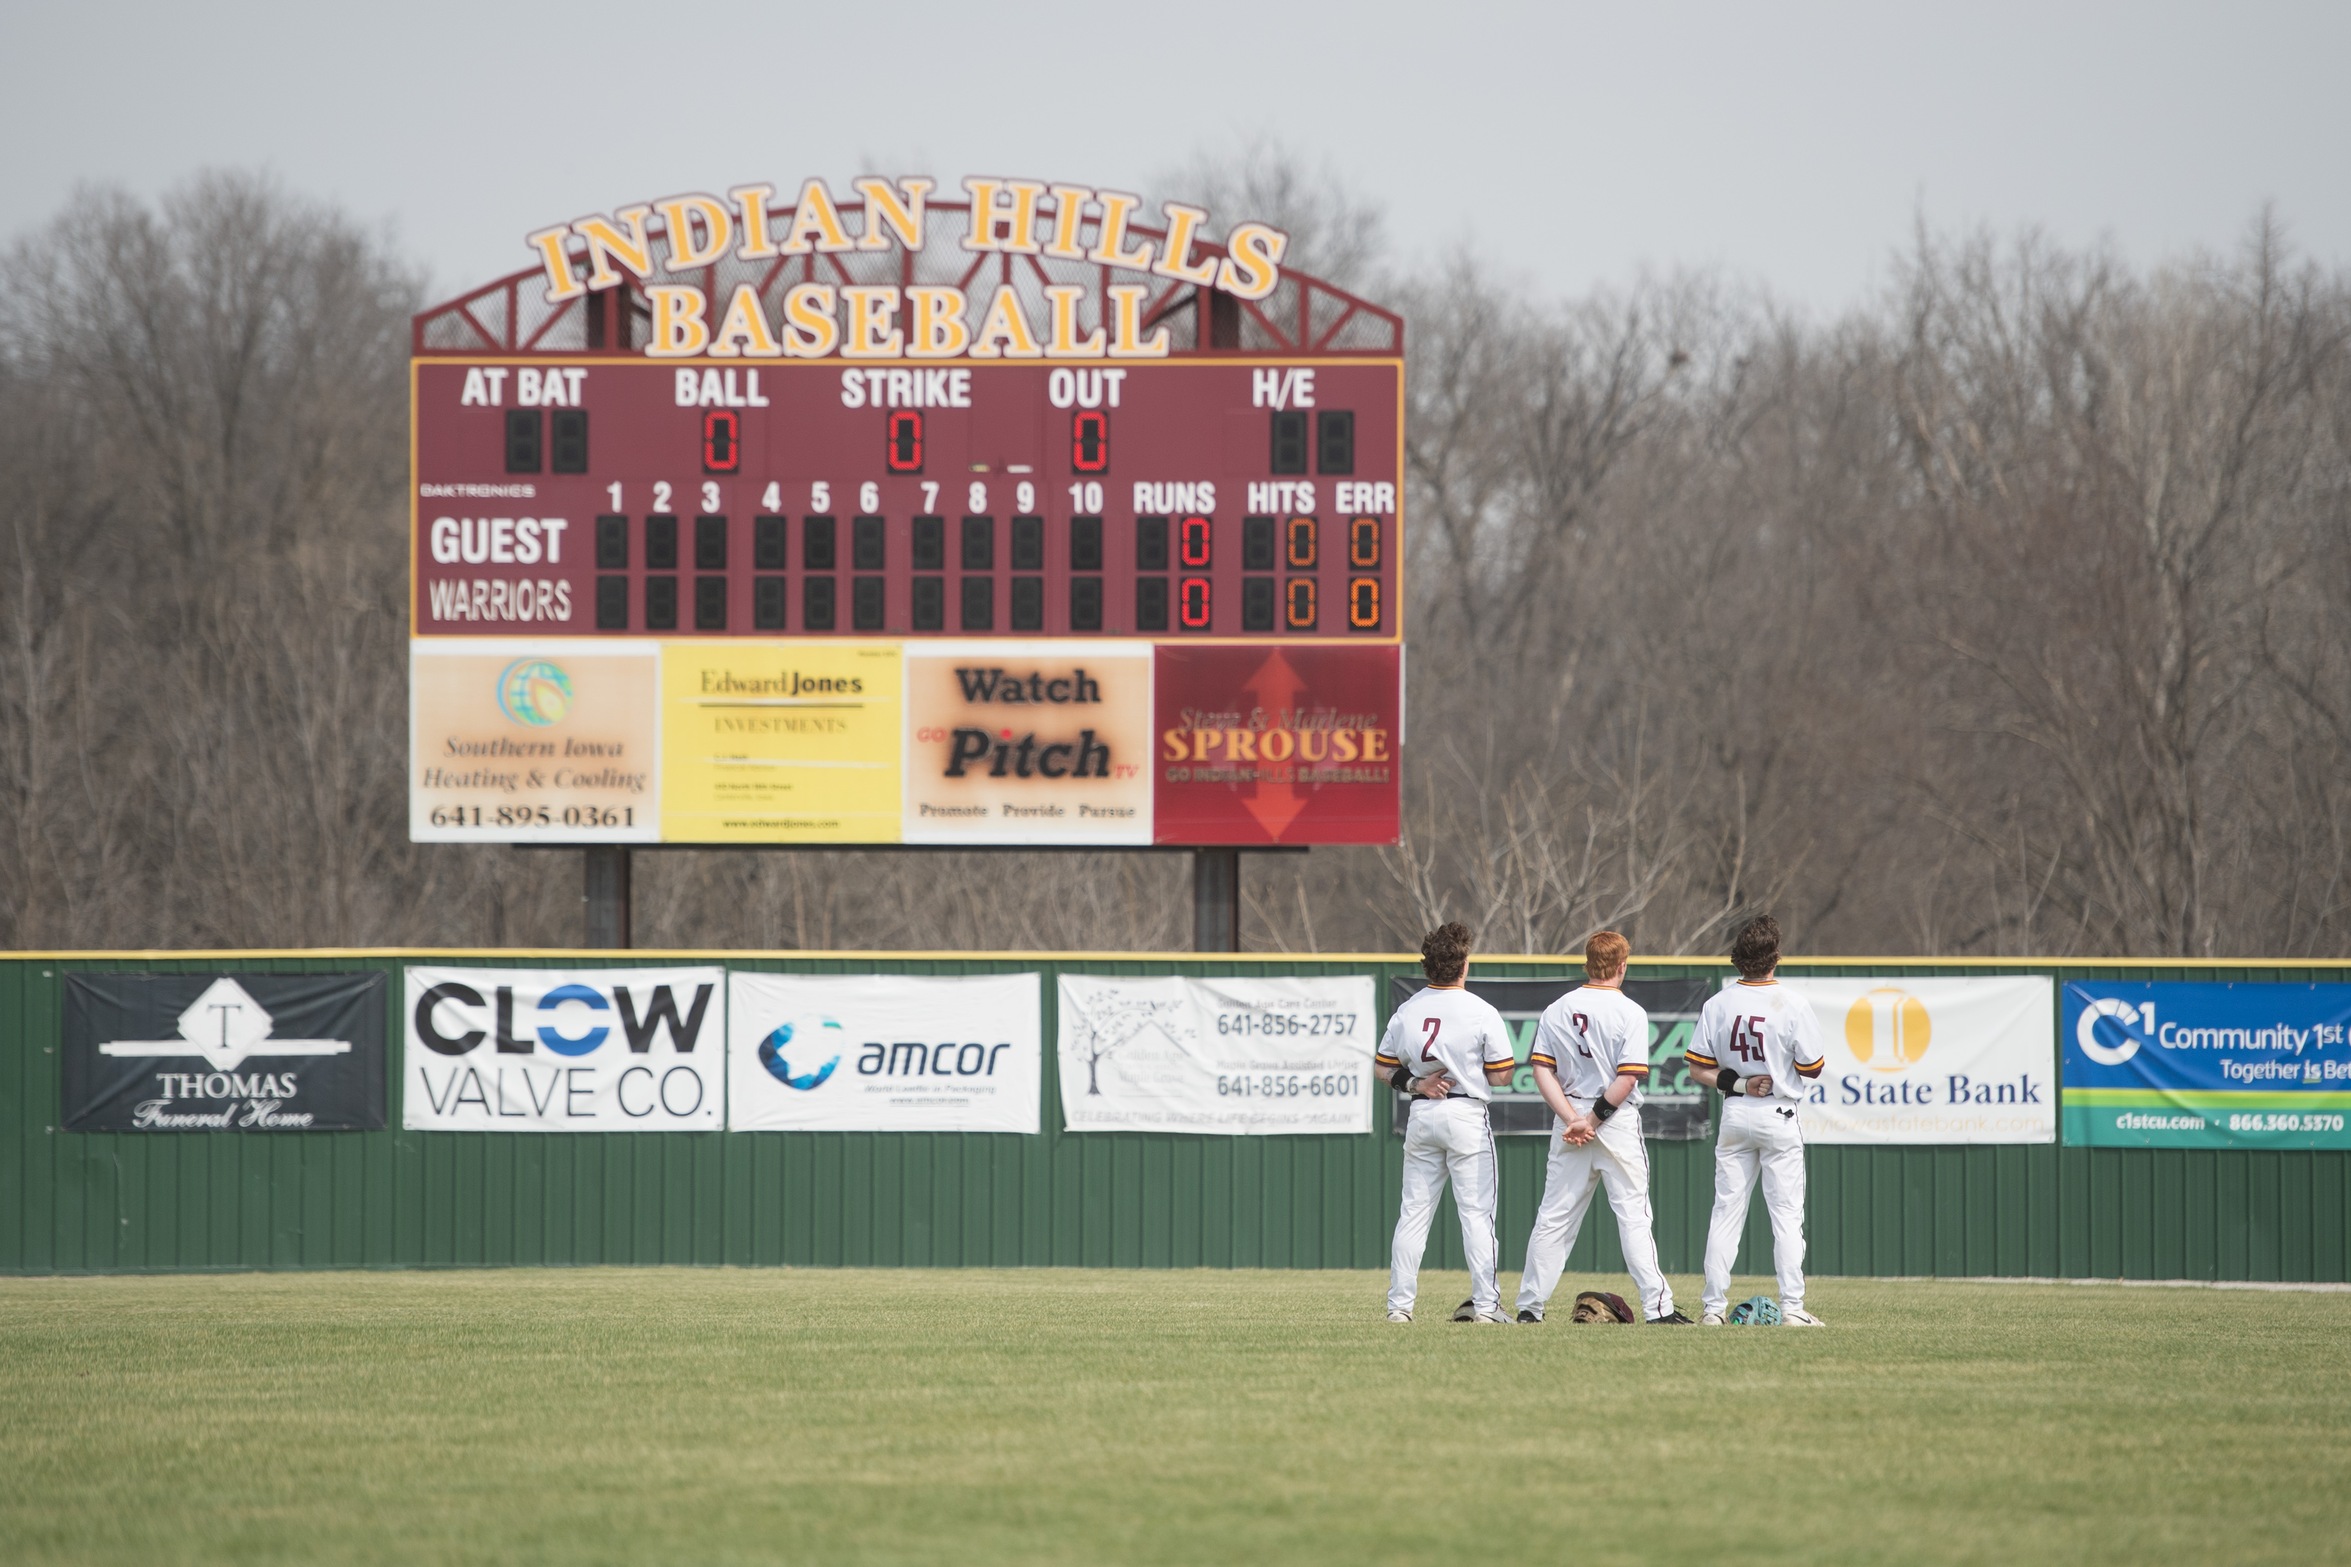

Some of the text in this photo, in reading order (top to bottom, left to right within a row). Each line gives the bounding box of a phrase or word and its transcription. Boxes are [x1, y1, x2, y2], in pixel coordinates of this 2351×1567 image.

[527, 175, 1288, 302] INDIAN HILLS
[645, 283, 1170, 358] BASEBALL
[461, 368, 588, 407] AT BAT
[675, 368, 770, 407] BALL
[840, 367, 972, 408] STRIKE
[1049, 368, 1127, 408] OUT
[1252, 367, 1316, 411] H/E
[704, 410, 738, 470] 0
[889, 411, 922, 471] 0
[1073, 411, 1108, 471] 0
[420, 483, 536, 498] DAKTRONICS
[607, 481, 1395, 514] 1 2 3 4 5 6 7 8 9 10 RUNS HITS ERR
[430, 517, 568, 564] GUEST
[1181, 517, 1380, 566] 0 0 0
[429, 579, 572, 622] WARRIORS
[1181, 578, 1380, 628] 0 0 0
[954, 667, 1102, 704] Watch
[714, 716, 848, 734] INVESTMENTS
[444, 736, 625, 758] Southern Iowa
[917, 727, 948, 743] GO
[944, 728, 1111, 779] Pitch
[1163, 728, 1390, 762] SPROUSE
[423, 767, 647, 794] Heating & Cooling
[430, 803, 635, 829] 641-895-0361
[1003, 803, 1064, 817] Provide
[207, 1003, 242, 1049] T
[415, 982, 715, 1057] CLOW
[1217, 1013, 1358, 1036] 641-856-2757
[1730, 1015, 1766, 1063] 45
[2159, 1022, 2309, 1056] Community
[2312, 1022, 2344, 1049] 1st
[857, 1042, 1011, 1076] amcor
[1421, 1018, 1441, 1062] 2
[156, 1072, 298, 1098] THOMAS
[1217, 1074, 1360, 1097] 641-856-6601
[1841, 1074, 1933, 1105] State
[1946, 1072, 2042, 1105] Bank
[2220, 1059, 2300, 1083] Together
[2303, 1059, 2321, 1079] is
[420, 1065, 713, 1117] VALVE CO.
[132, 1099, 314, 1128] Funeral Home
[2116, 1112, 2205, 1130] c1stcu.com
